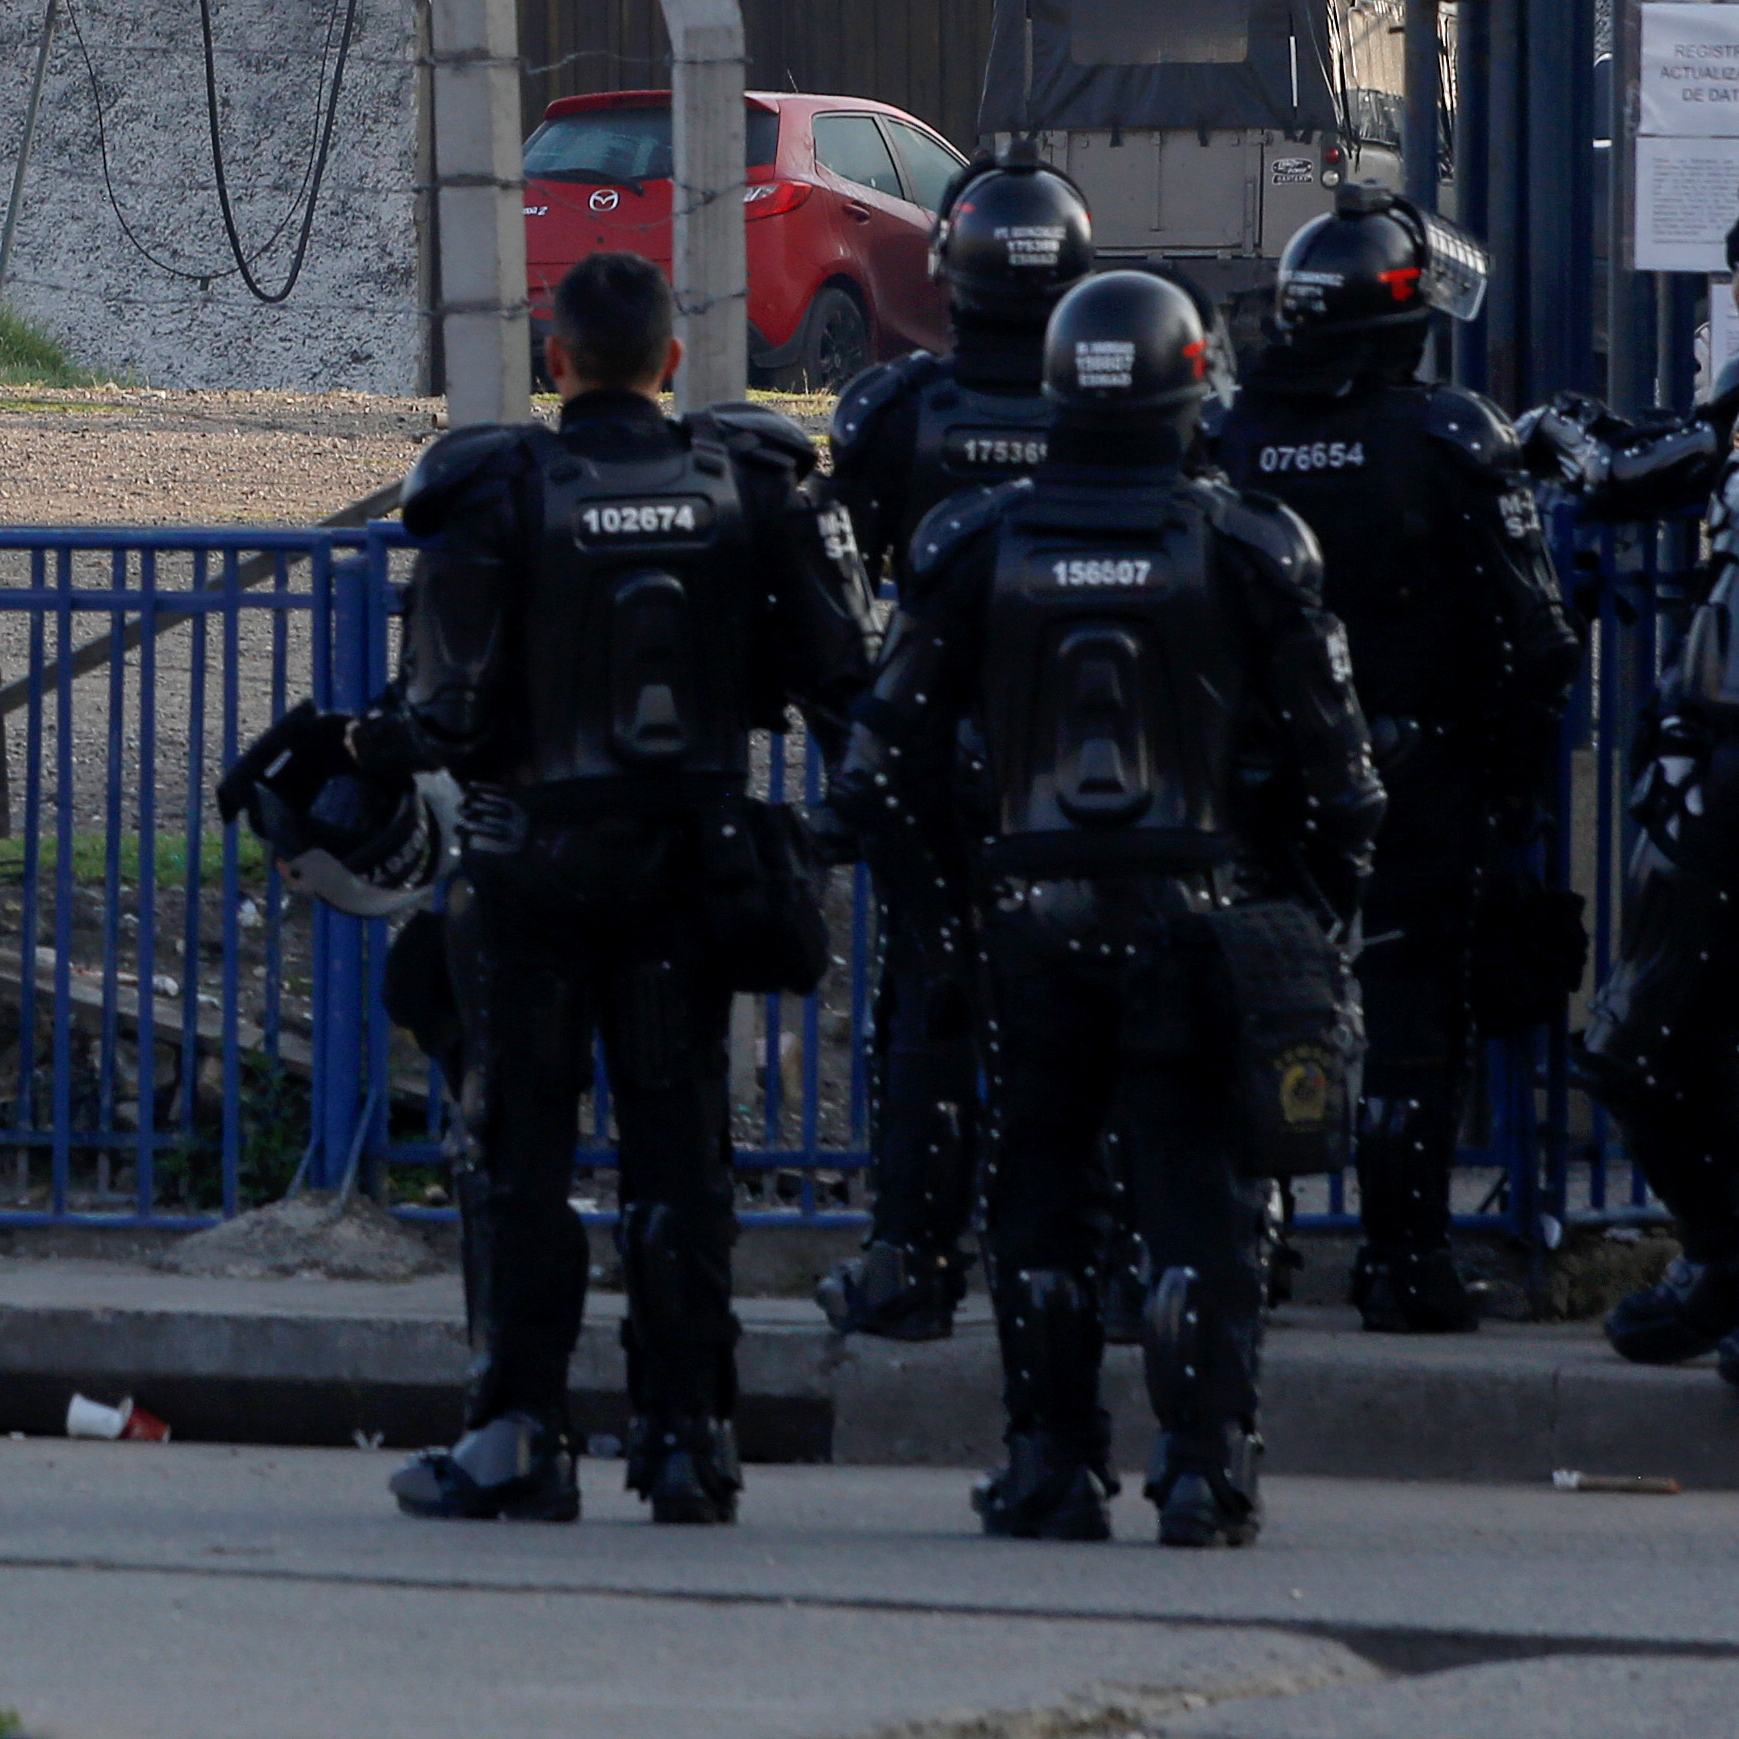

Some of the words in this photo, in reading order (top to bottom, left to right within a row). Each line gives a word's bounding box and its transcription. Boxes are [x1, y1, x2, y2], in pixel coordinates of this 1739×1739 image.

[1659, 66, 1739, 80] ACTUALIZ
[1682, 88, 1704, 101] DE
[1259, 441, 1366, 473] 076654
[582, 504, 696, 534] 102674
